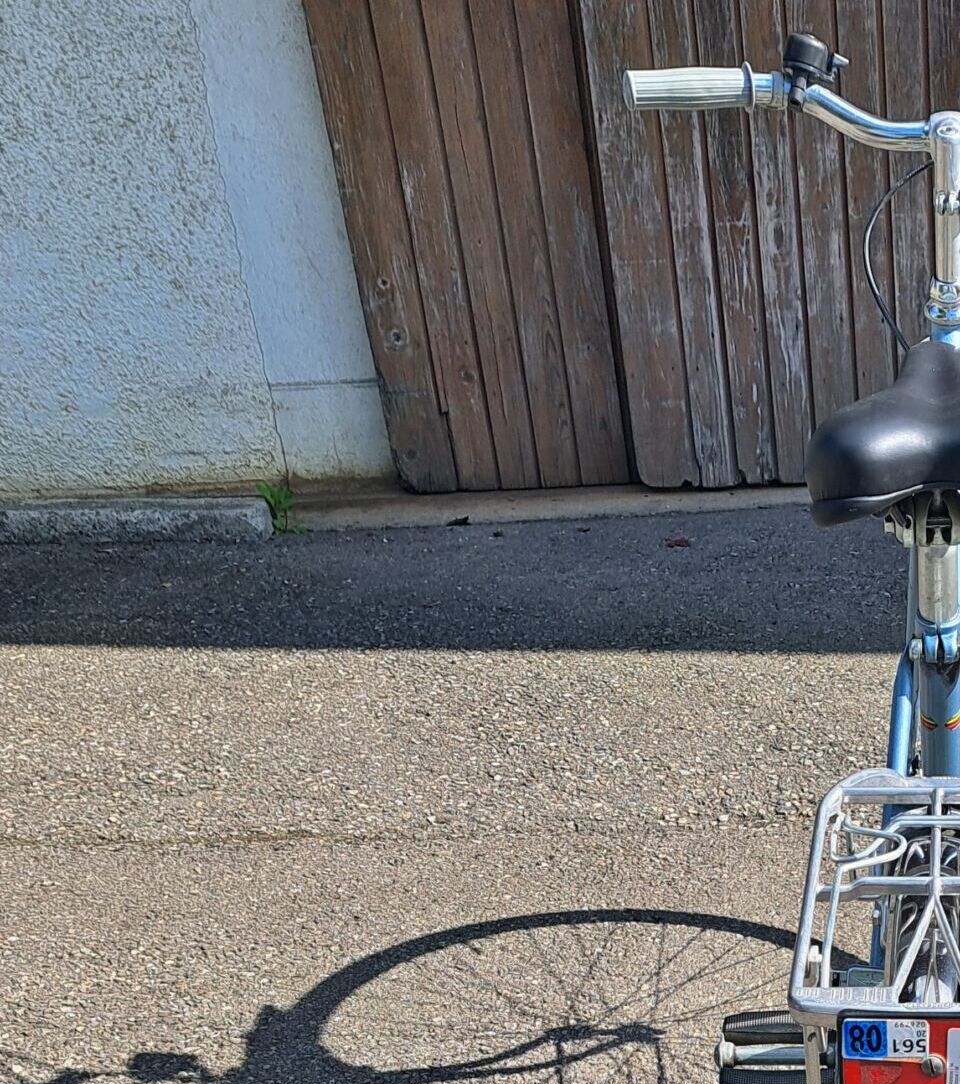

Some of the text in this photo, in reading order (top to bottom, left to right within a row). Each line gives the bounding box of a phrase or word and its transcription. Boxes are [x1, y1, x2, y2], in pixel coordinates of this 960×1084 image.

[849, 1024, 883, 1055] 08
[916, 1030, 926, 1038] 20
[893, 1038, 927, 1053] 561
